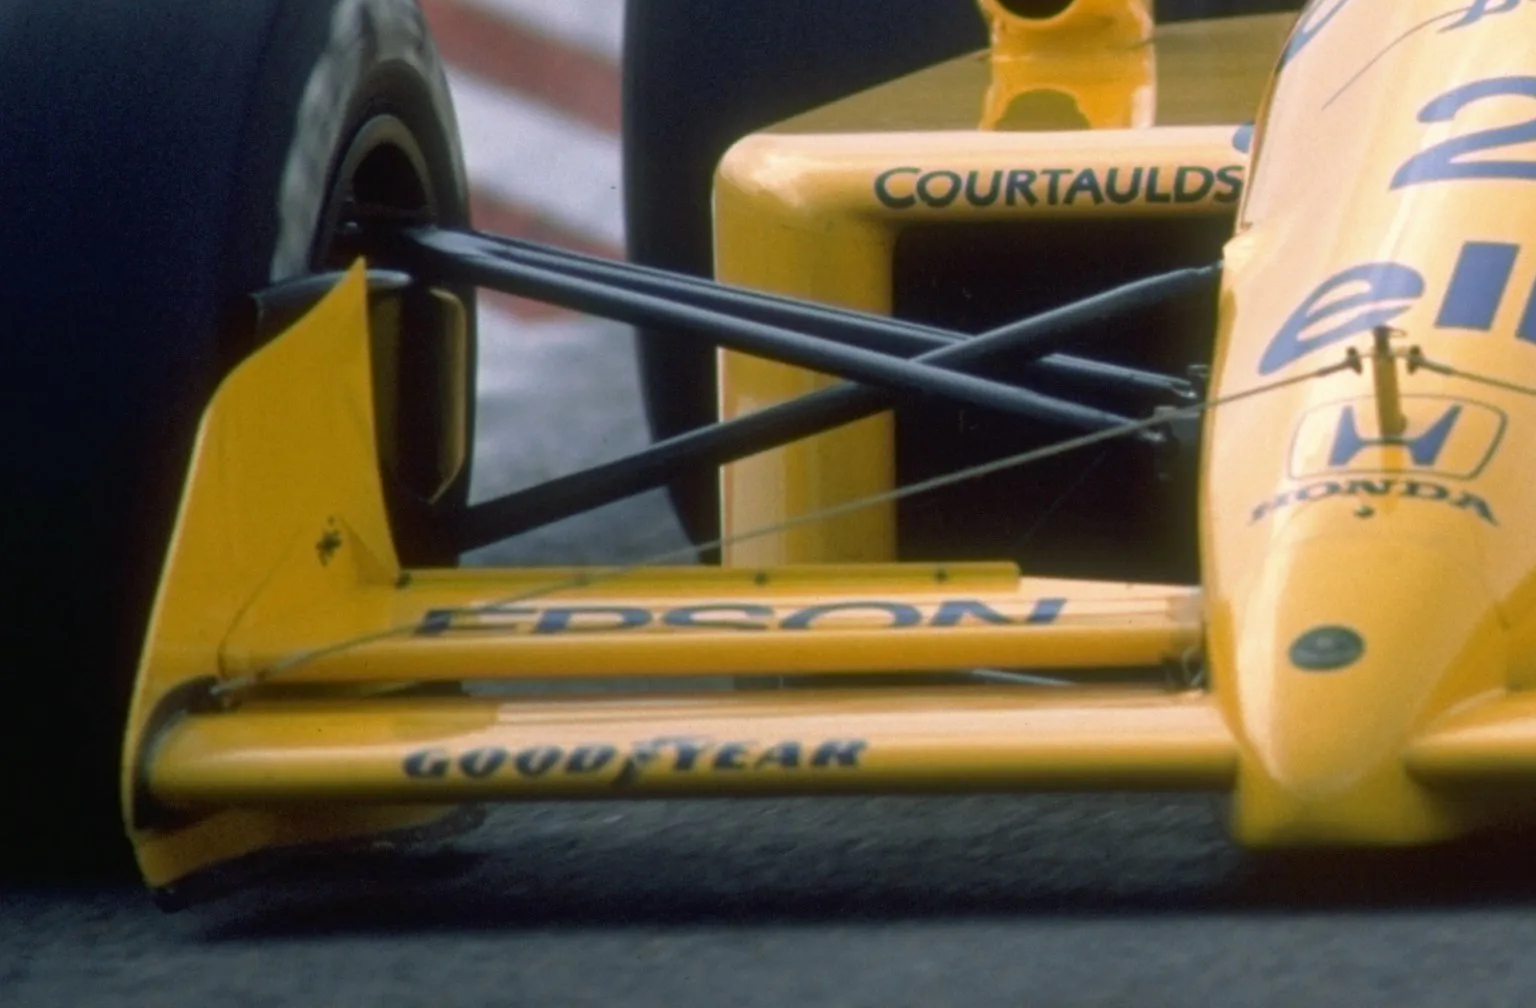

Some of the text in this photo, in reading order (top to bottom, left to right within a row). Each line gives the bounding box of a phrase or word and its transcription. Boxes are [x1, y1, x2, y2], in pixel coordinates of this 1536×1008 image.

[874, 165, 1244, 209] COURTAULDS
[1248, 479, 1498, 525] HONDA
[415, 598, 1067, 636] EPSON
